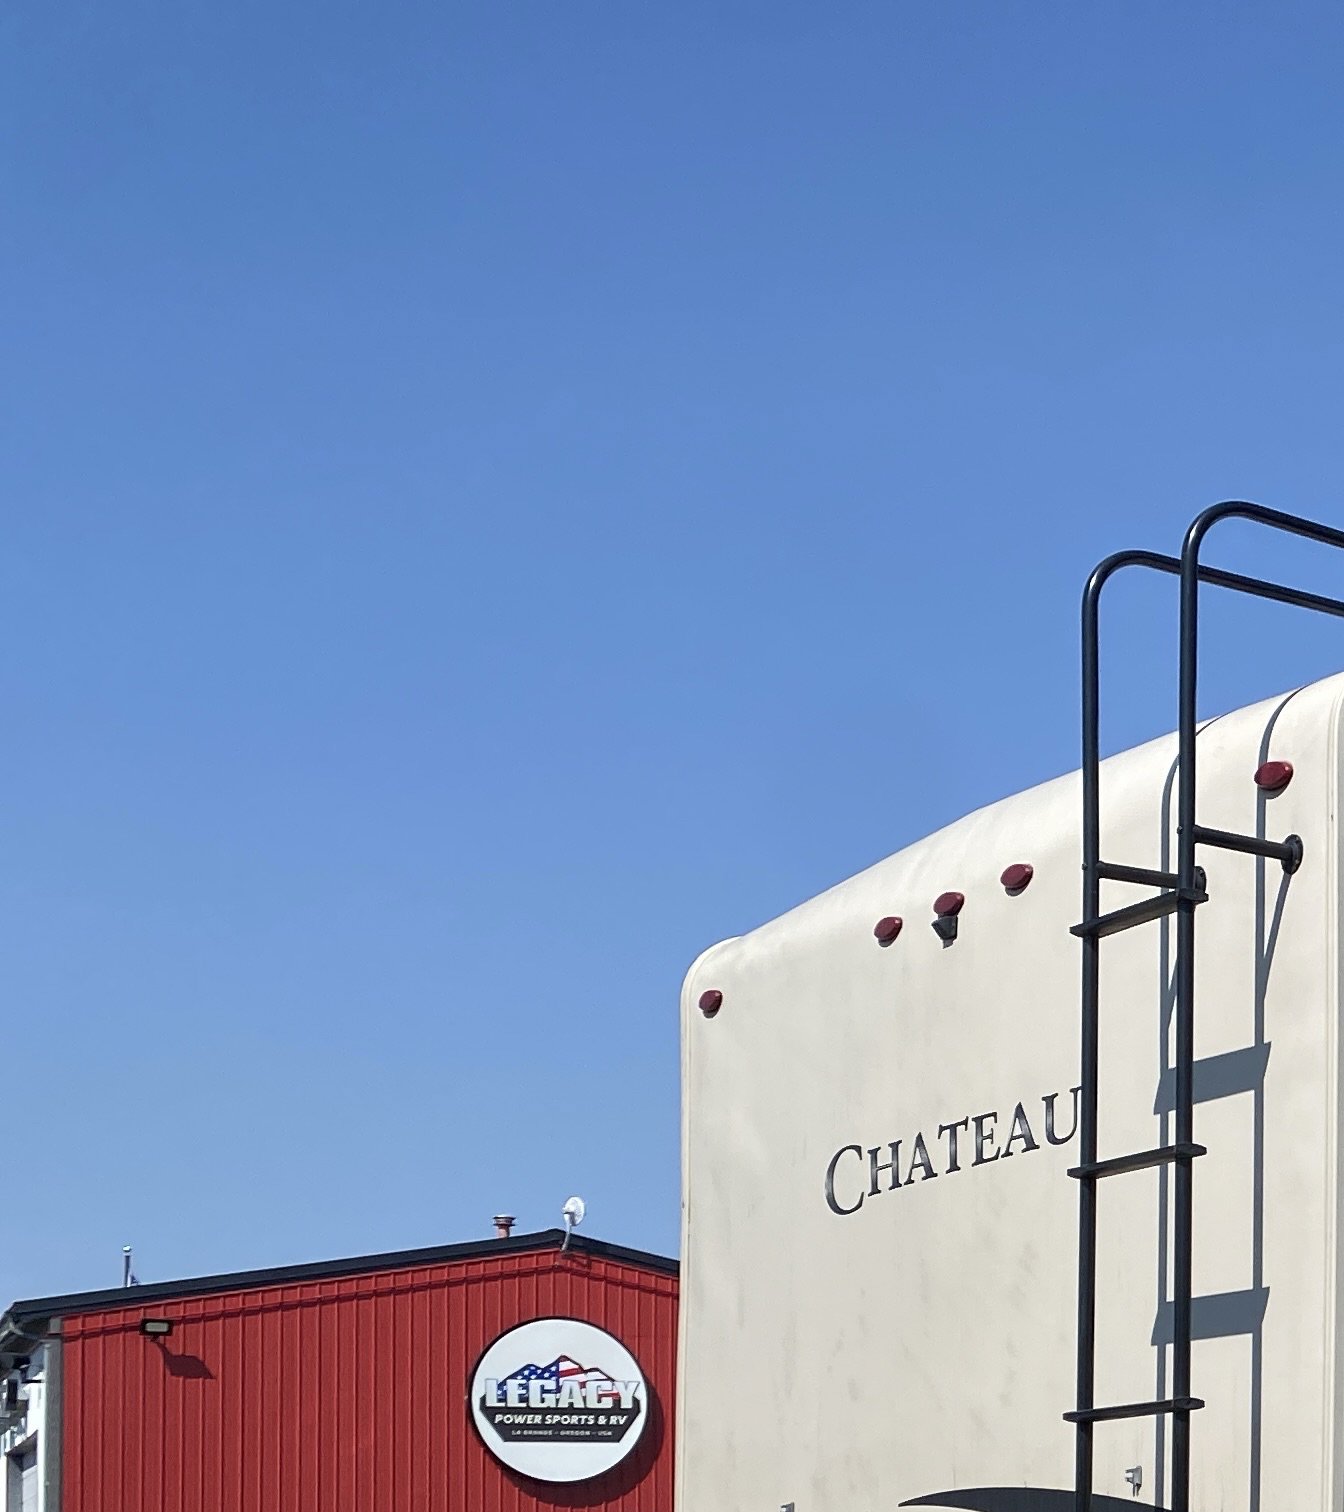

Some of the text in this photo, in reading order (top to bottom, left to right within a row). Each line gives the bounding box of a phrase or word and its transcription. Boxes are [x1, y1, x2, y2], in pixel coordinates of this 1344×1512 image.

[824, 1086, 1082, 1216] CHATEAU
[484, 1378, 640, 1409] LEGACY
[494, 1414, 628, 1425] POWER SPORTS & RV
